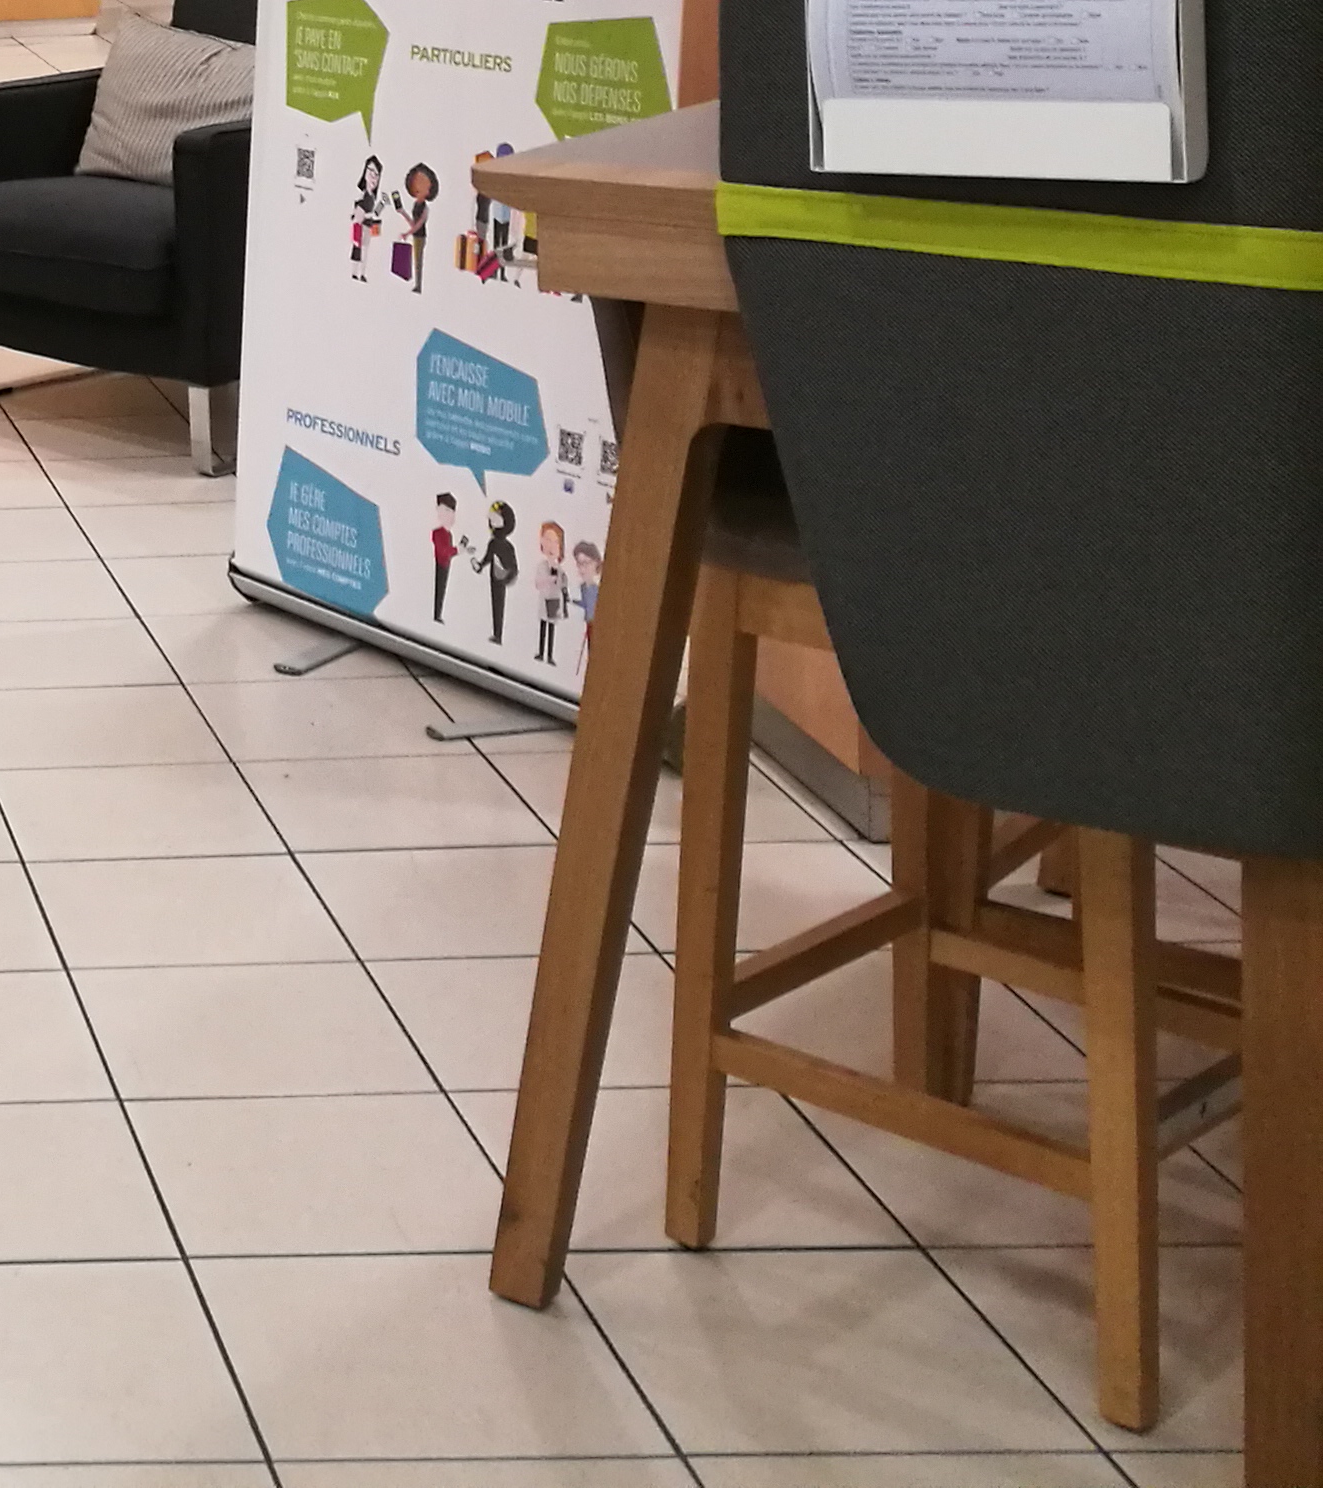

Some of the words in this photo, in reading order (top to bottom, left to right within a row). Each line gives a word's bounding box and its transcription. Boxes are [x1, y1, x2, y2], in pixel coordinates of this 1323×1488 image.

[328, 29, 342, 50] EN
[410, 44, 513, 73] PARTICULIERS
[555, 52, 587, 77] NOUS
[553, 80, 577, 104] NOS
[428, 381, 455, 407] AVEC
[457, 387, 485, 414] MON
[487, 394, 531, 427] MOBILE
[286, 408, 402, 456] PROFESSIONNELS
[288, 507, 311, 530] MES
[312, 514, 358, 548] COMPTES
[287, 530, 372, 580] PROFESSIONNELS
